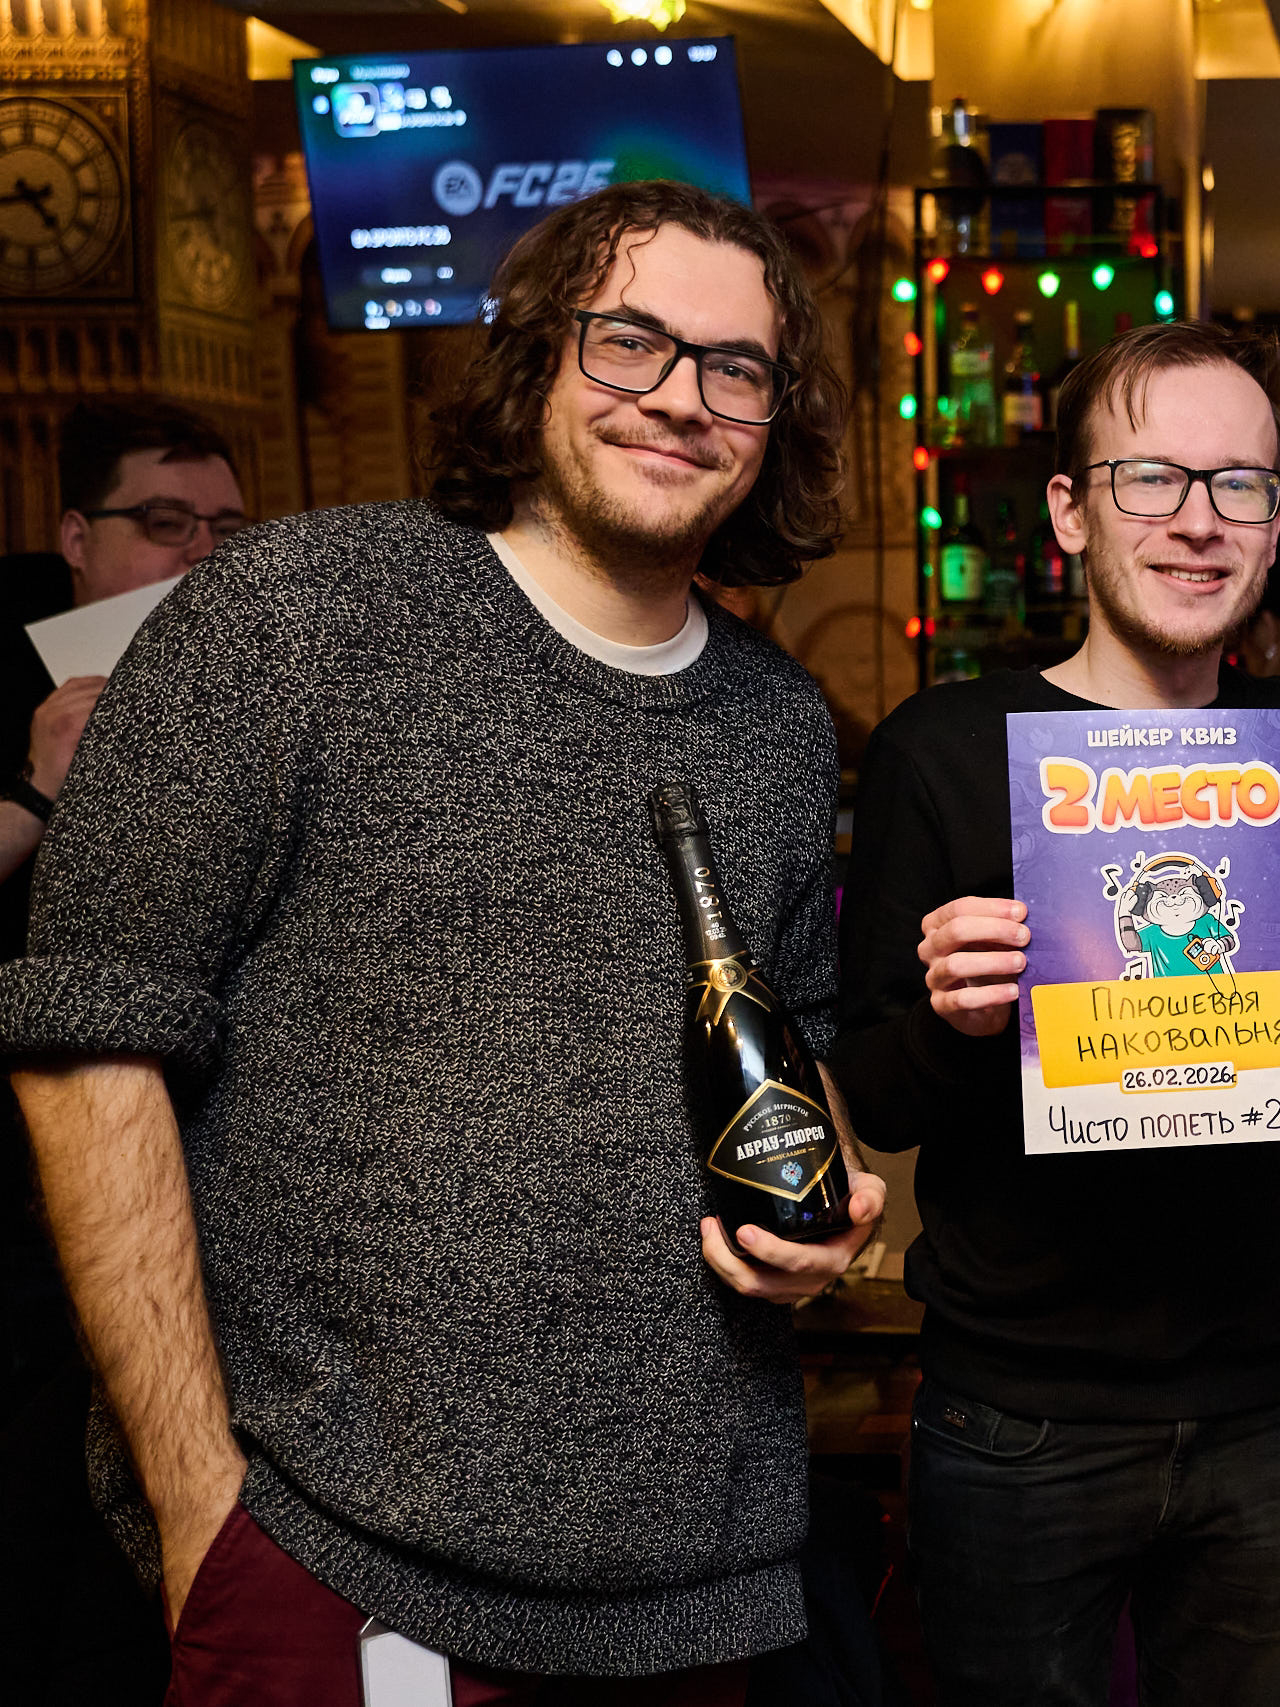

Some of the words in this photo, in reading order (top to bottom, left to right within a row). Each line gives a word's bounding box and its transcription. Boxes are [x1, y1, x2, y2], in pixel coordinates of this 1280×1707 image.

[1087, 725, 1173, 748] ШЕЙКЕР
[1181, 726, 1237, 746] КВИЗ
[1045, 763, 1090, 827] 2
[1101, 768, 1280, 827] МЕСТО
[695, 867, 722, 920] 1870
[764, 1113, 791, 1128] 1870
[736, 1125, 825, 1161] АБРАУ-ДЮРСО
